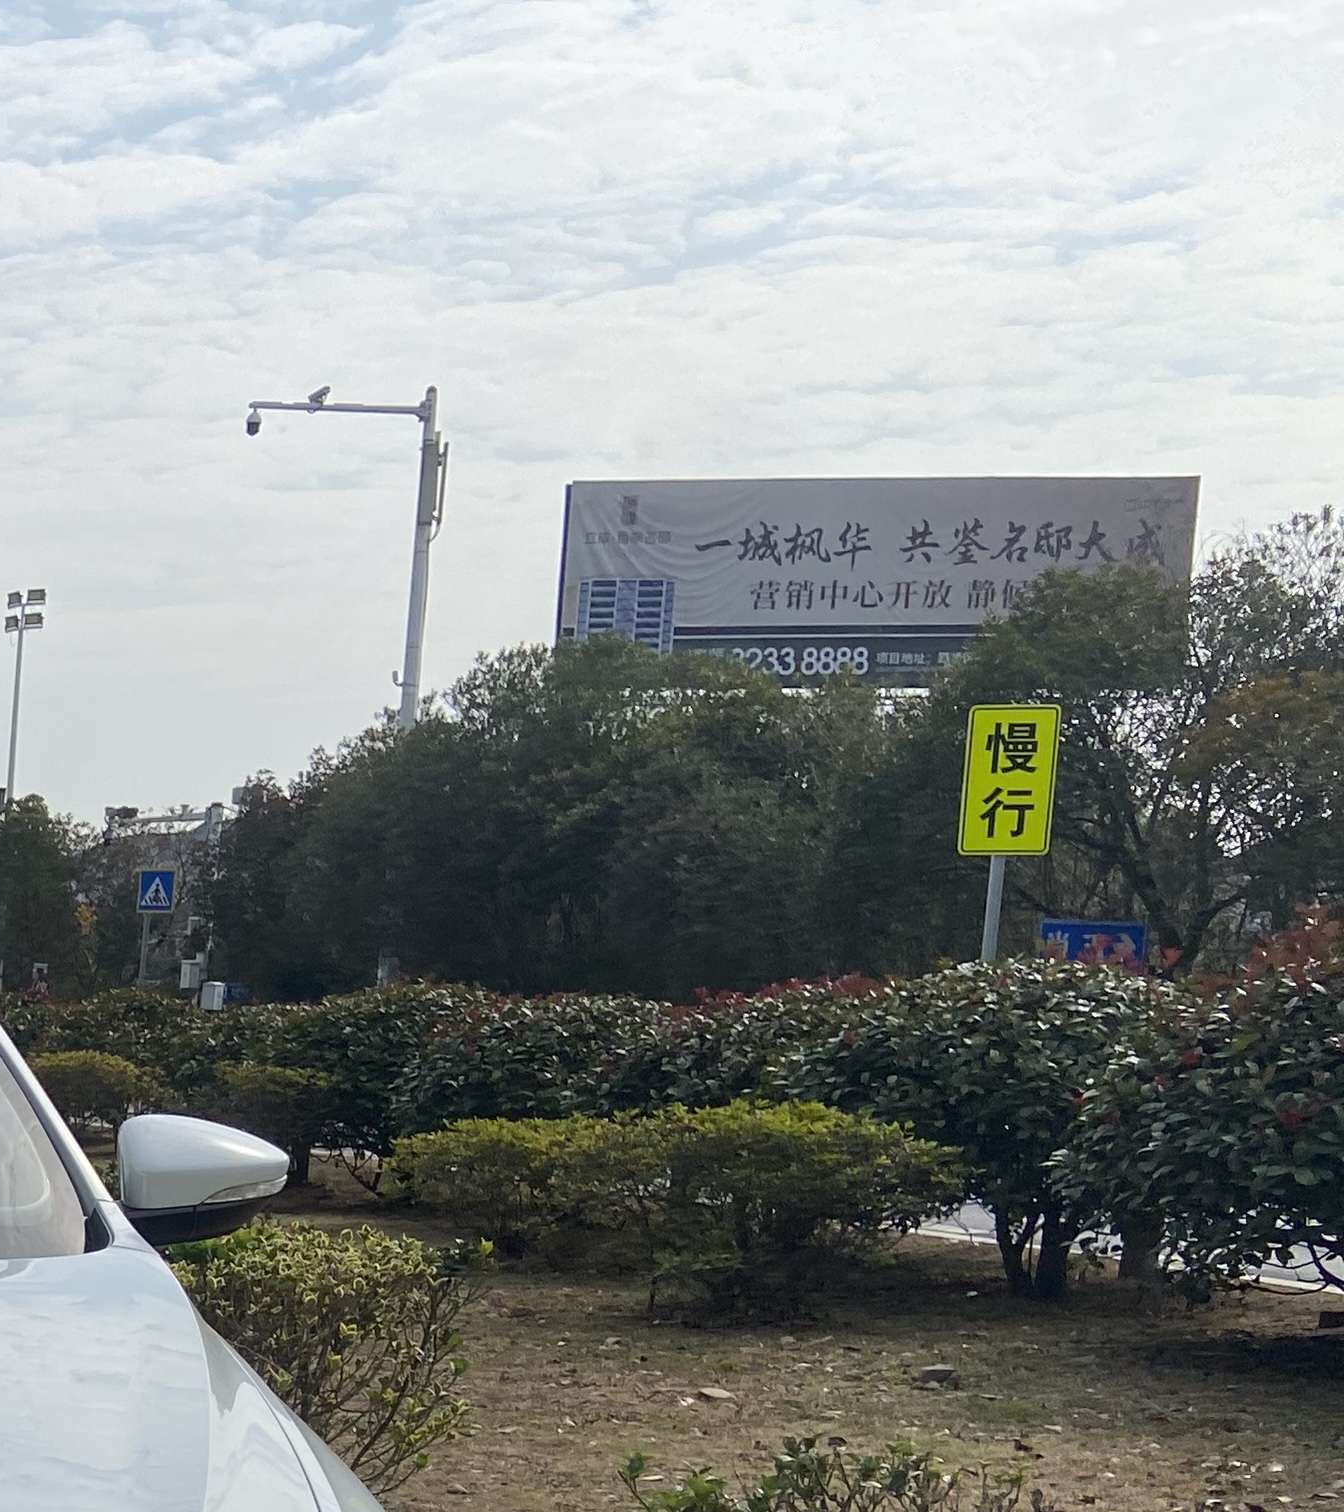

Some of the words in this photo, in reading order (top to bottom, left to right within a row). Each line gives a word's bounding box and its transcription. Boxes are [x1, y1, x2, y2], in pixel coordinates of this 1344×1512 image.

[695, 521, 873, 572] 一城枫华
[750, 579, 953, 610] 营销中心开放
[979, 722, 1040, 839] 慢行
